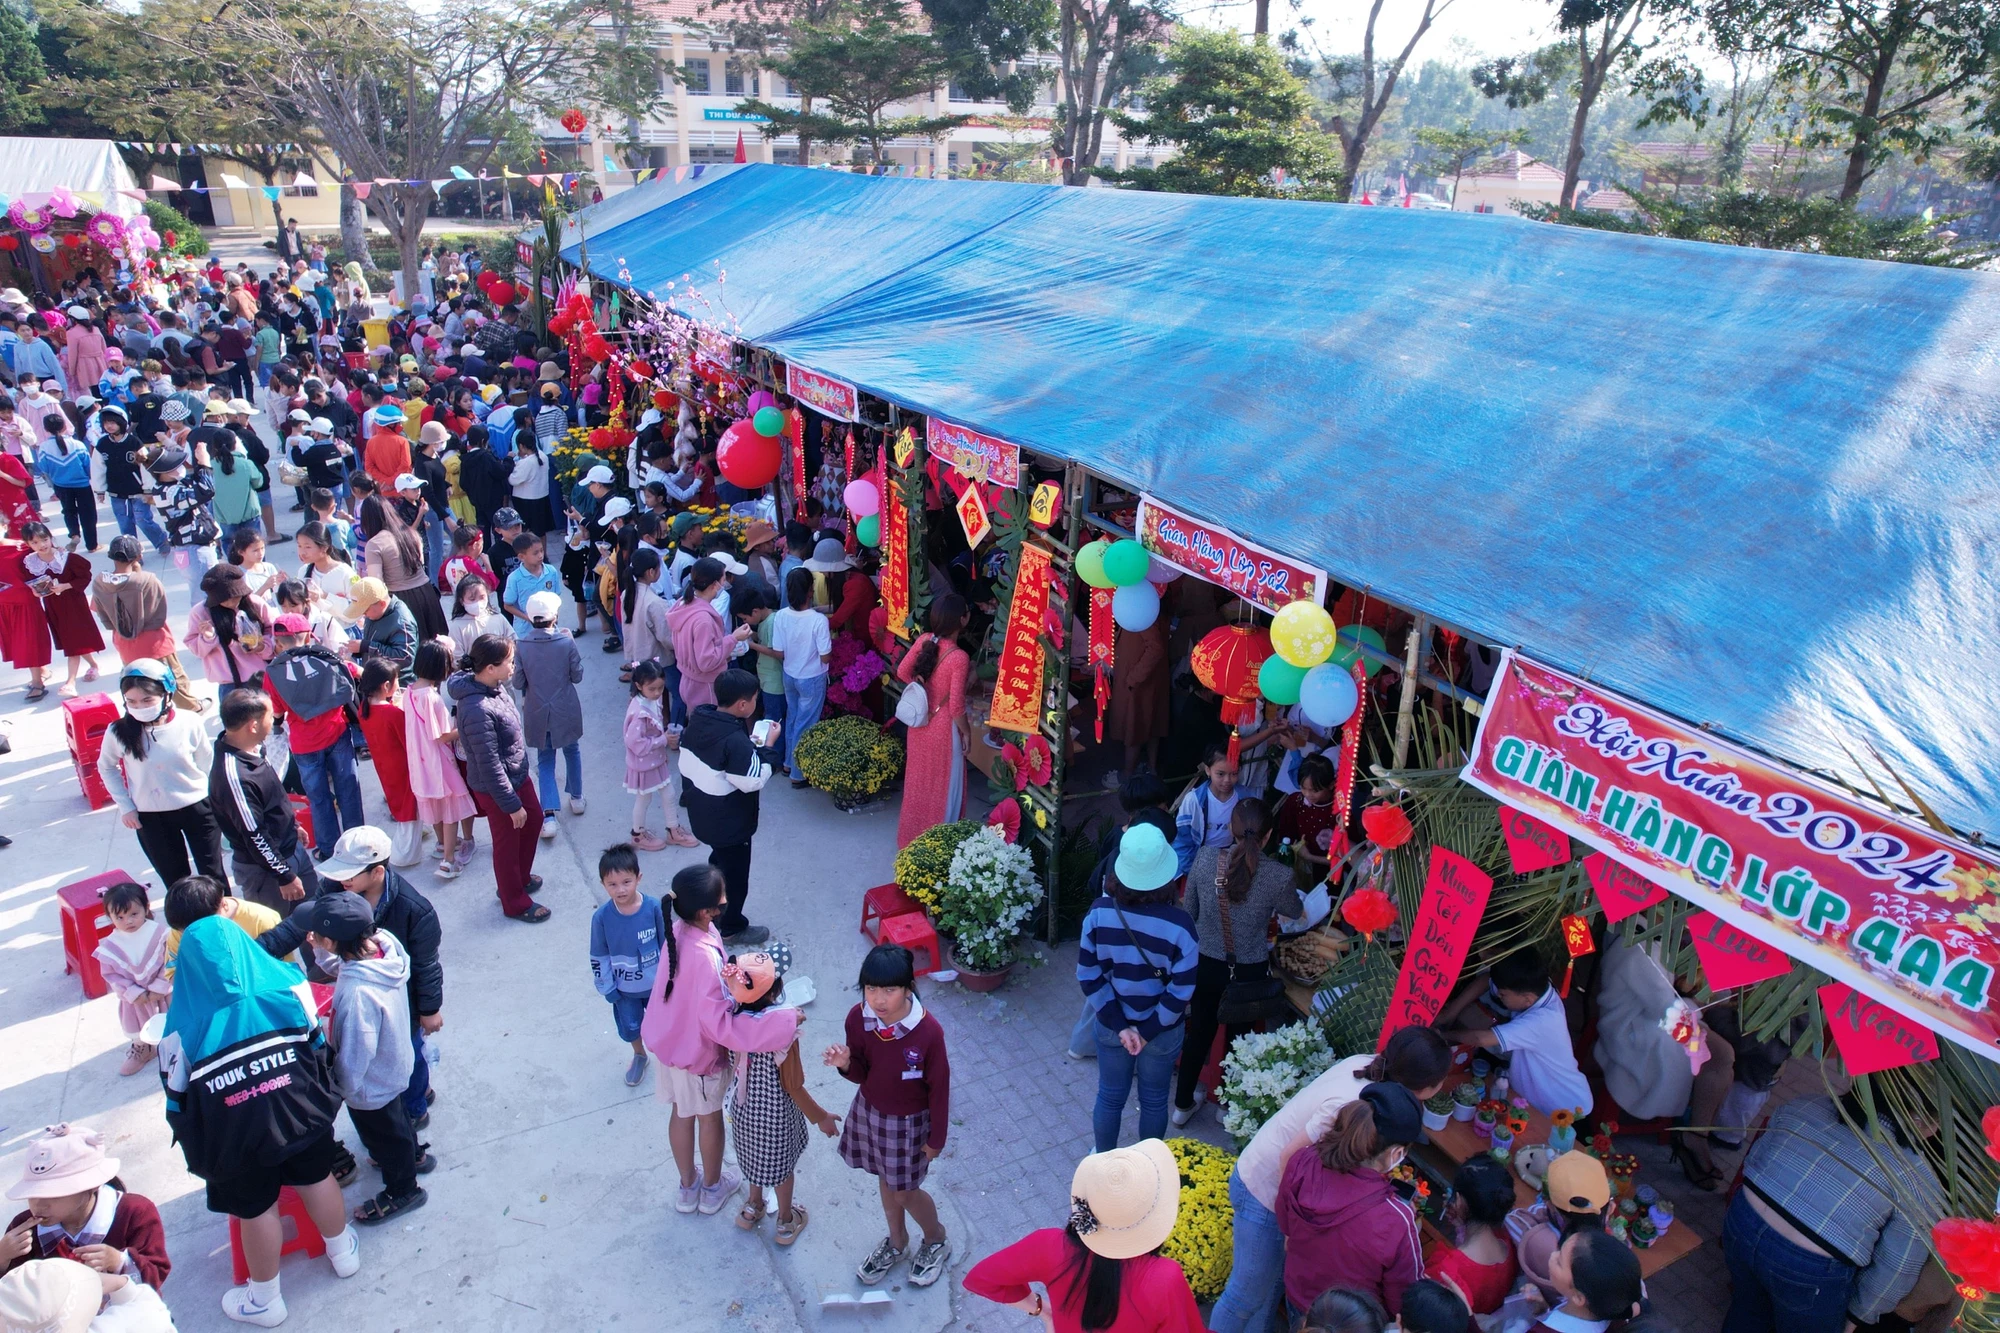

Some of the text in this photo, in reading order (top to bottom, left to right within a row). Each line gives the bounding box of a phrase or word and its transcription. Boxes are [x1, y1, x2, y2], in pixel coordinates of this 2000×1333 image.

[709, 111, 723, 119] THI
[1159, 518, 1291, 596] Gian Hàng Lớp 5a2
[1556, 703, 1952, 891] Hội Xuân 2024
[1495, 737, 1991, 1009] GIAN HÀNG LỚP 4A4
[1435, 889, 1462, 926] Tết
[1414, 947, 1450, 990] Góp
[205, 1047, 298, 1095] YOUK STYLE
